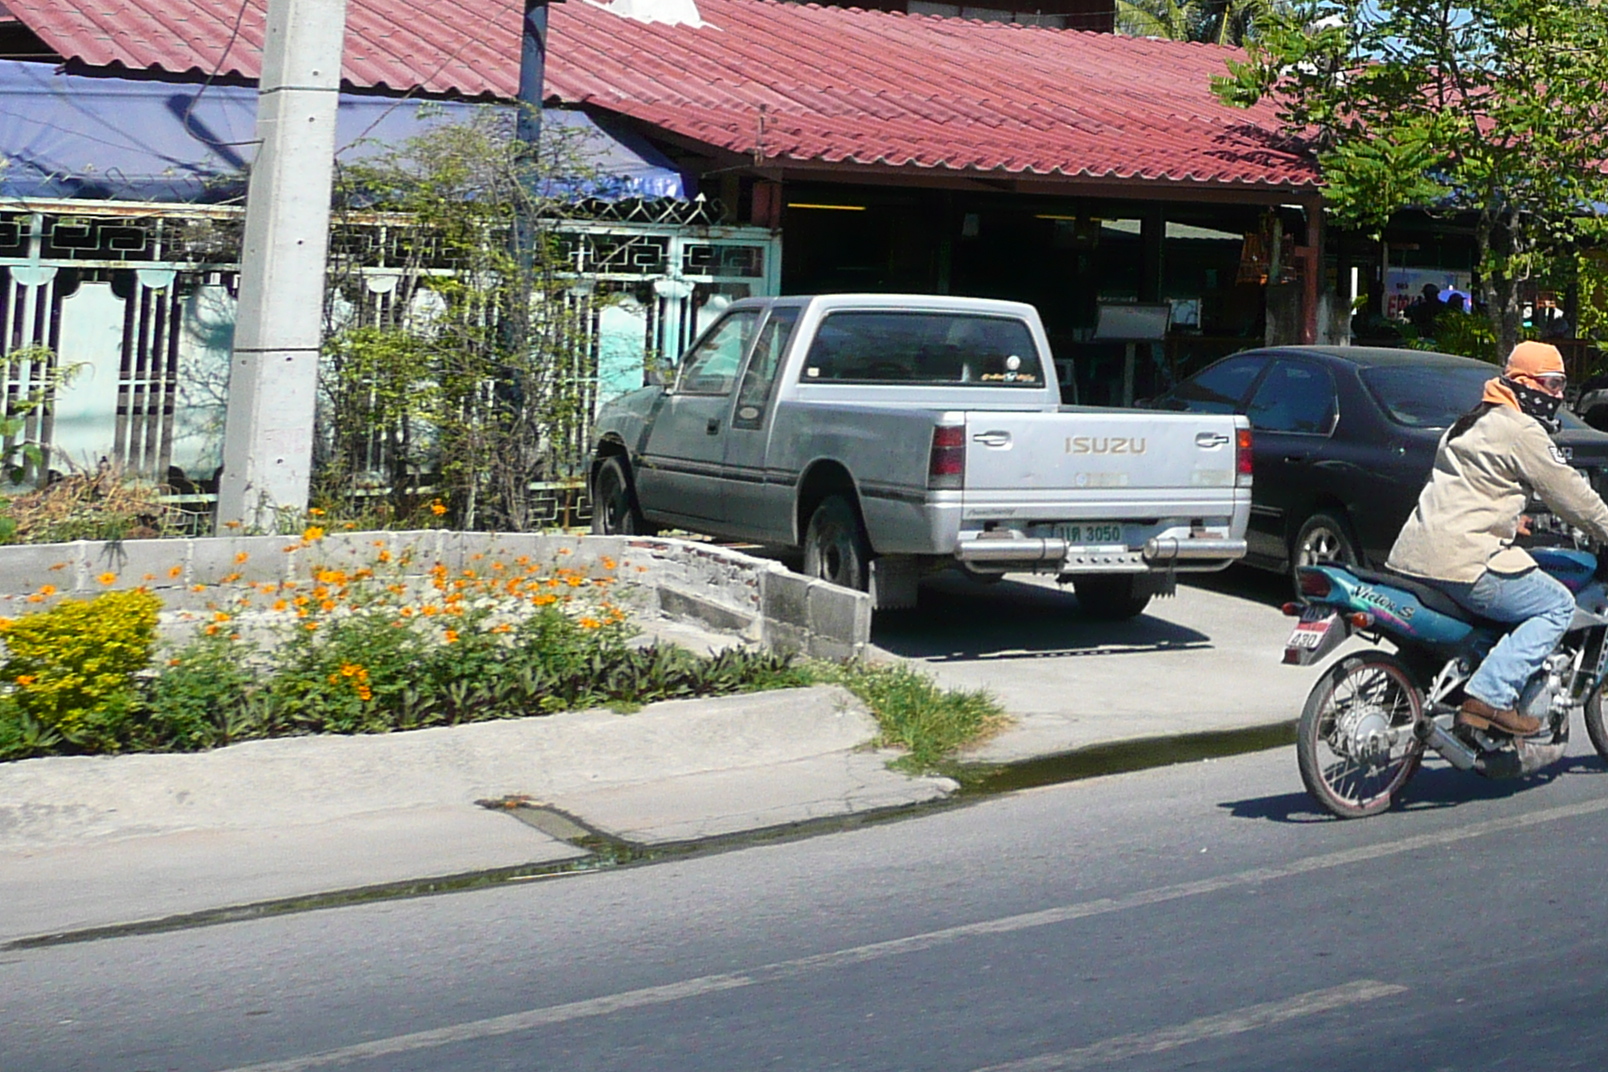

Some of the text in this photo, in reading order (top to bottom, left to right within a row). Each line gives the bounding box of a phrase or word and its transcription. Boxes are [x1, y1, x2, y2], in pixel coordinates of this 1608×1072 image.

[1065, 437, 1146, 454] ISUZU
[1085, 526, 1121, 541] 3050
[1398, 606, 1414, 618] S
